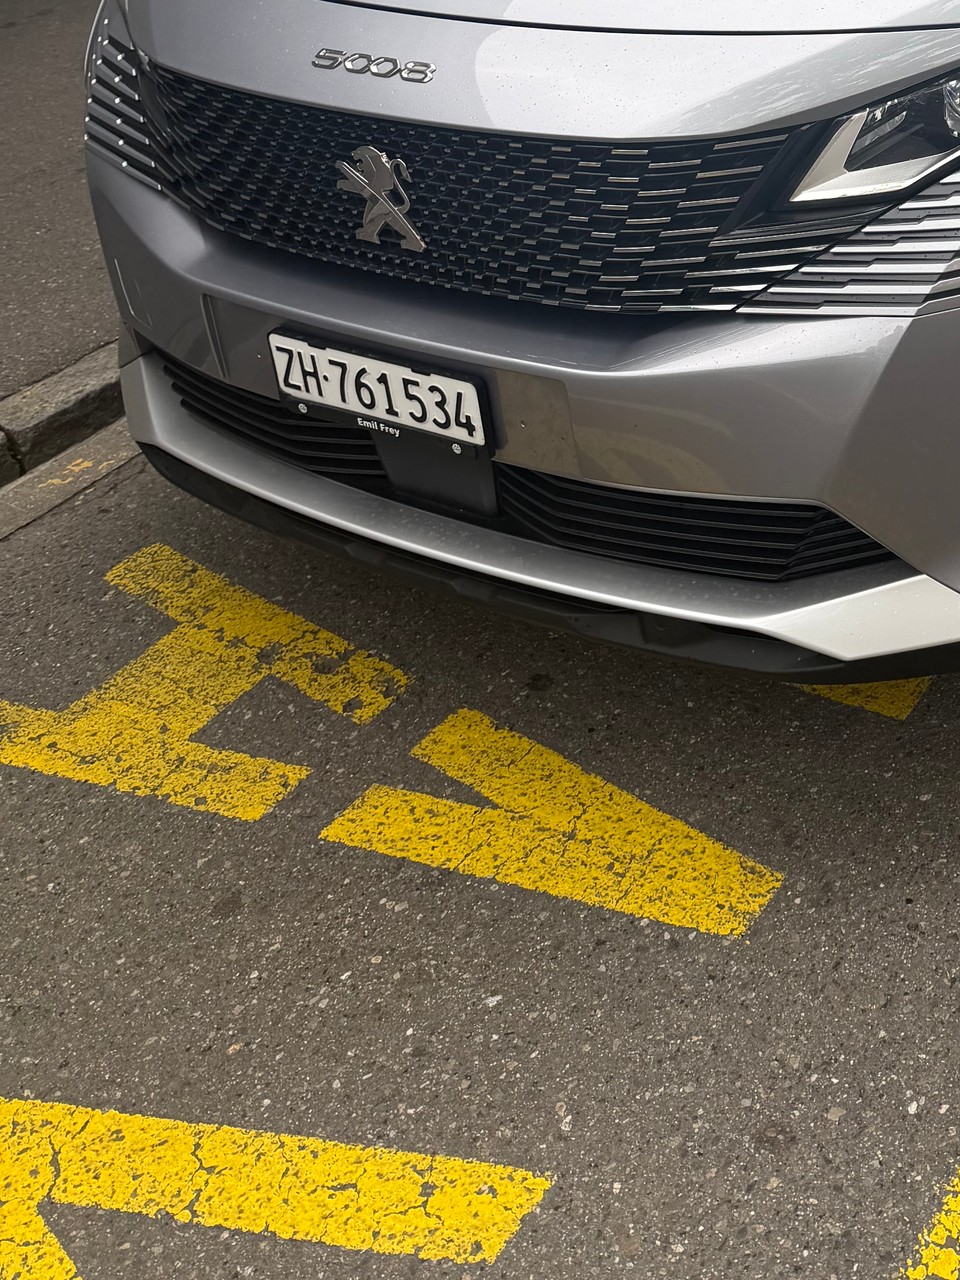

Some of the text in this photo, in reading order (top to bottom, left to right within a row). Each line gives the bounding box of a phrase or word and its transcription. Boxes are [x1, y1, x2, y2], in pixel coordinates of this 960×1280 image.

[312, 48, 437, 83] 5008
[357, 418, 400, 438] Emil Frey
